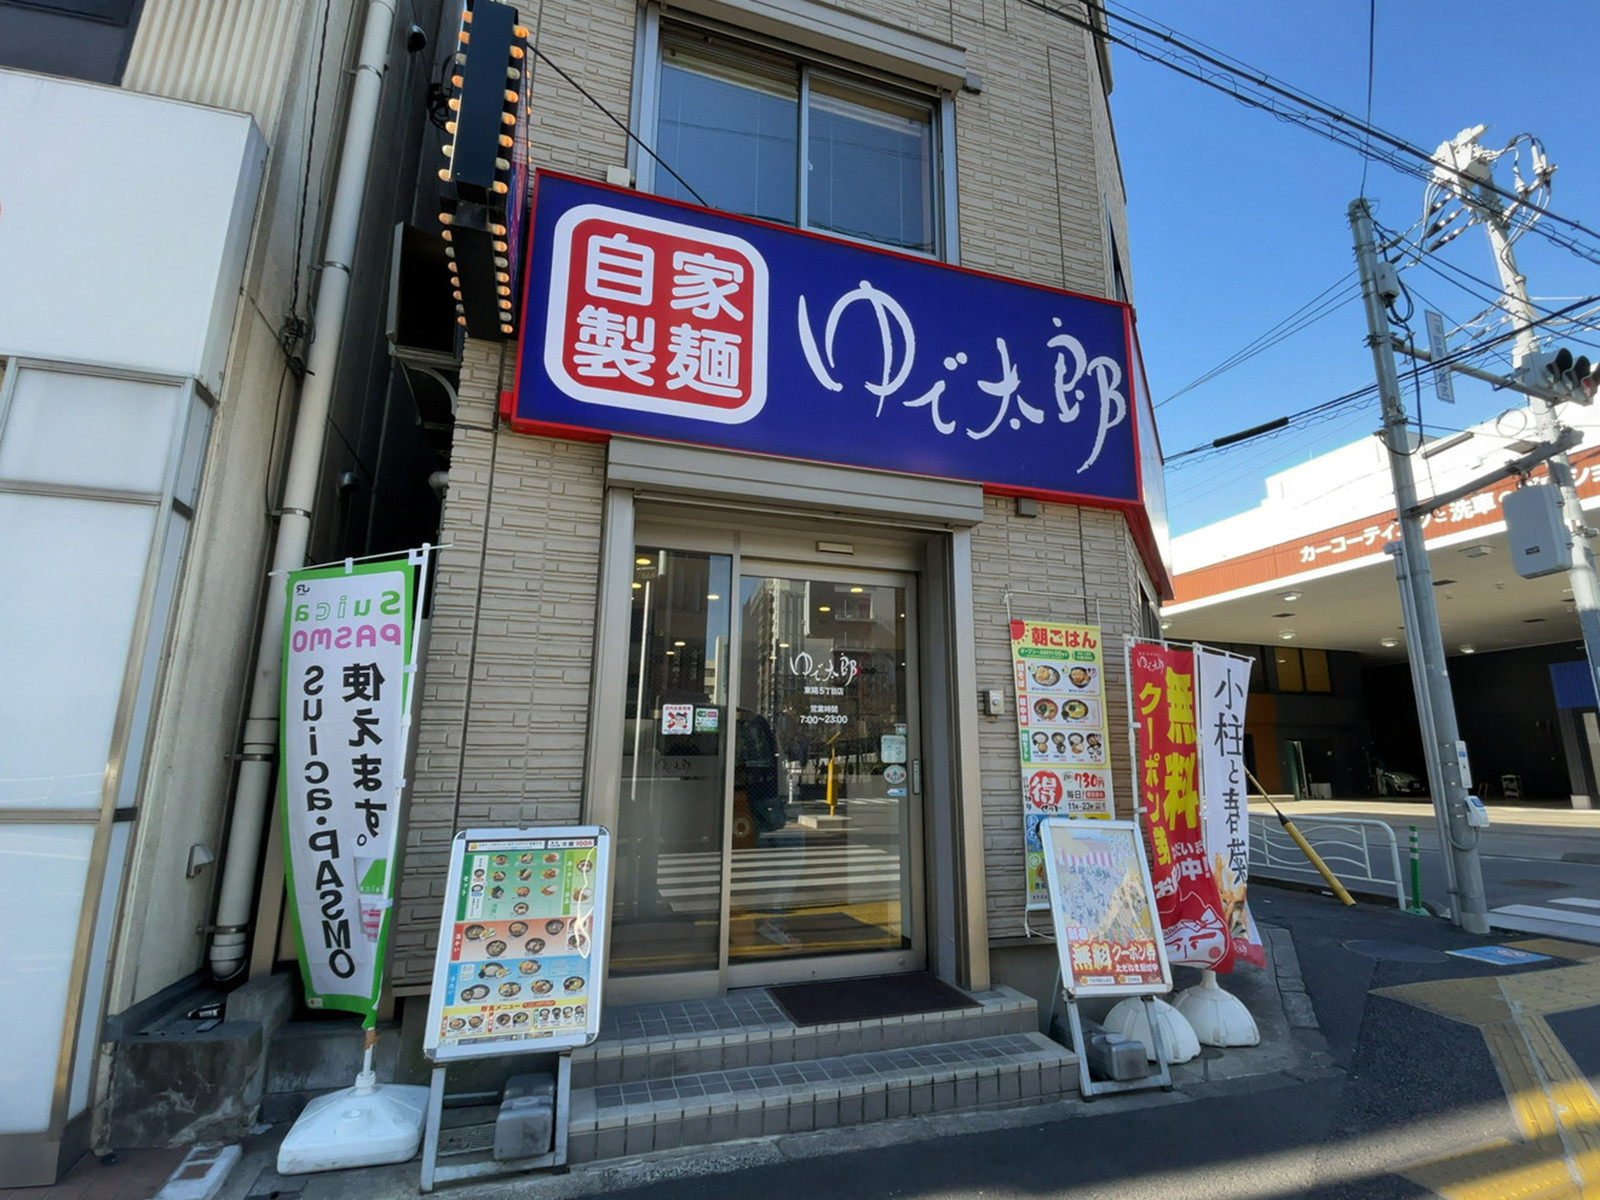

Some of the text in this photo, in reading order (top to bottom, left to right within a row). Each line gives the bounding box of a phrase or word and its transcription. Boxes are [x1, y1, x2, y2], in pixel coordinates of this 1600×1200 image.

[585, 233, 744, 322] 自家
[573, 304, 743, 399] 製麺
[799, 280, 1126, 474] ゆで太郎
[1031, 627, 1097, 649] 朝ごはん
[789, 652, 857, 687] ゆで太郎
[810, 704, 839, 714] 営業時間
[1138, 682, 1172, 866] クーポン券
[1163, 666, 1200, 832] 無料
[1213, 668, 1248, 885] 小柱と春菊
[1030, 776, 1058, 805] 得
[1072, 943, 1113, 972] 無料
[1112, 942, 1157, 962] クーポン券
